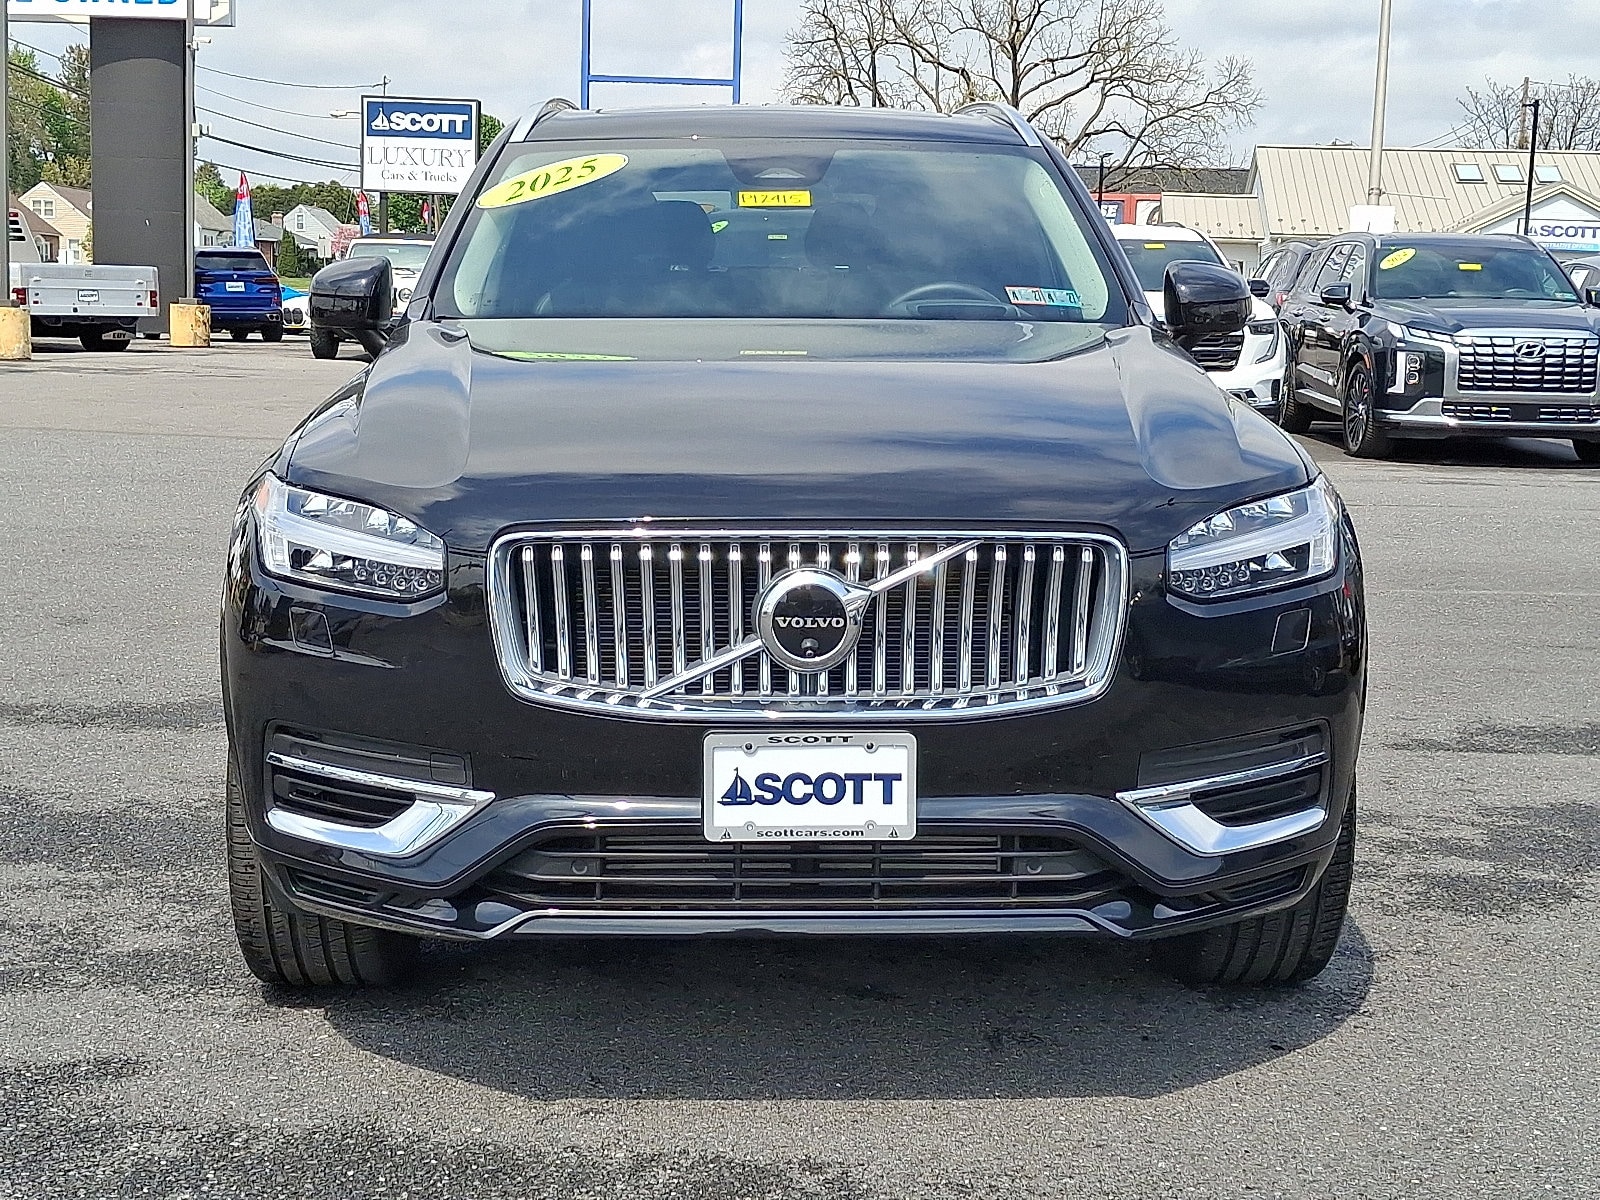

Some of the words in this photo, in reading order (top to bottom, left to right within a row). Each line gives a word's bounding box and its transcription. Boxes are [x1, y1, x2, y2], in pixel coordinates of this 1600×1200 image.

[389, 111, 469, 134] SCOTT
[367, 146, 472, 168] LUXURY
[381, 169, 405, 181] Cars
[408, 171, 418, 181] &
[421, 170, 458, 183] Trucks
[505, 158, 598, 202] 2025
[1539, 225, 1600, 239] SCOTT
[775, 616, 845, 628] VOLVO
[767, 735, 854, 744] SCOTT
[754, 772, 902, 805] SCOTT
[756, 828, 865, 838] scottcars.com
